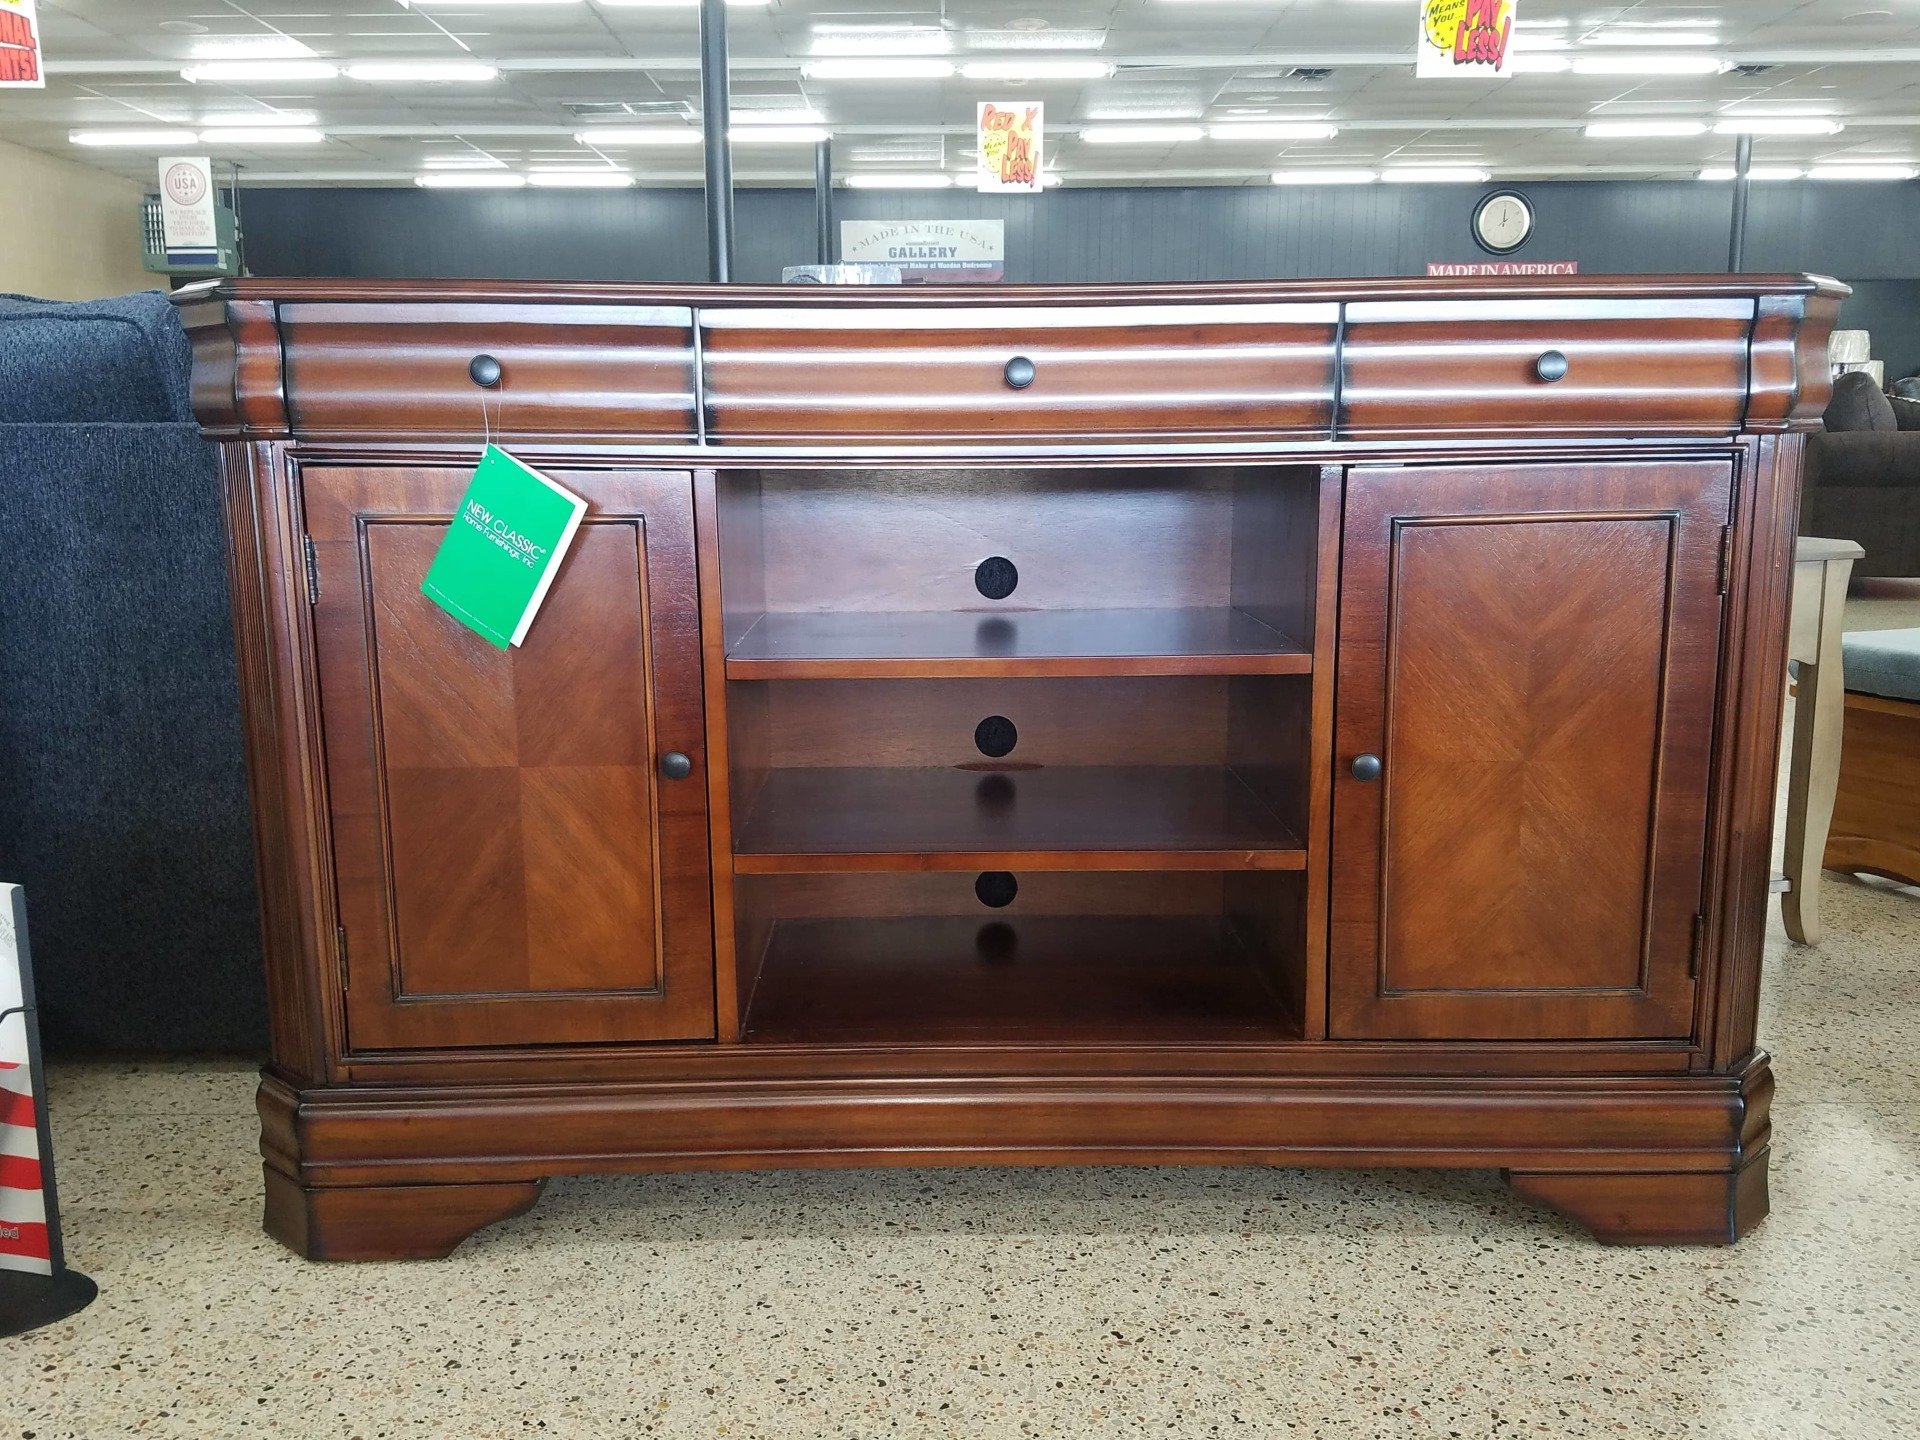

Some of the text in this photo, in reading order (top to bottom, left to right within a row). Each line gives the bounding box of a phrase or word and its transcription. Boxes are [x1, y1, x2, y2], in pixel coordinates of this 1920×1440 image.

[1429, 0, 1465, 17] MEANS
[1465, 0, 1503, 31] PAY
[0, 9, 36, 49] NAL
[1454, 16, 1511, 72] LESS!
[981, 103, 1038, 131] RED X
[1007, 130, 1031, 161] PAY
[1001, 151, 1039, 188] LESS!
[174, 178, 197, 190] USA
[860, 225, 986, 249] MADE IN THE USA
[888, 246, 958, 259] GALLERY
[1429, 263, 1574, 276] MADE IN AMERICA
[467, 499, 494, 524] NEW
[463, 512, 483, 532] Home
[522, 555, 535, 570] Inc.
